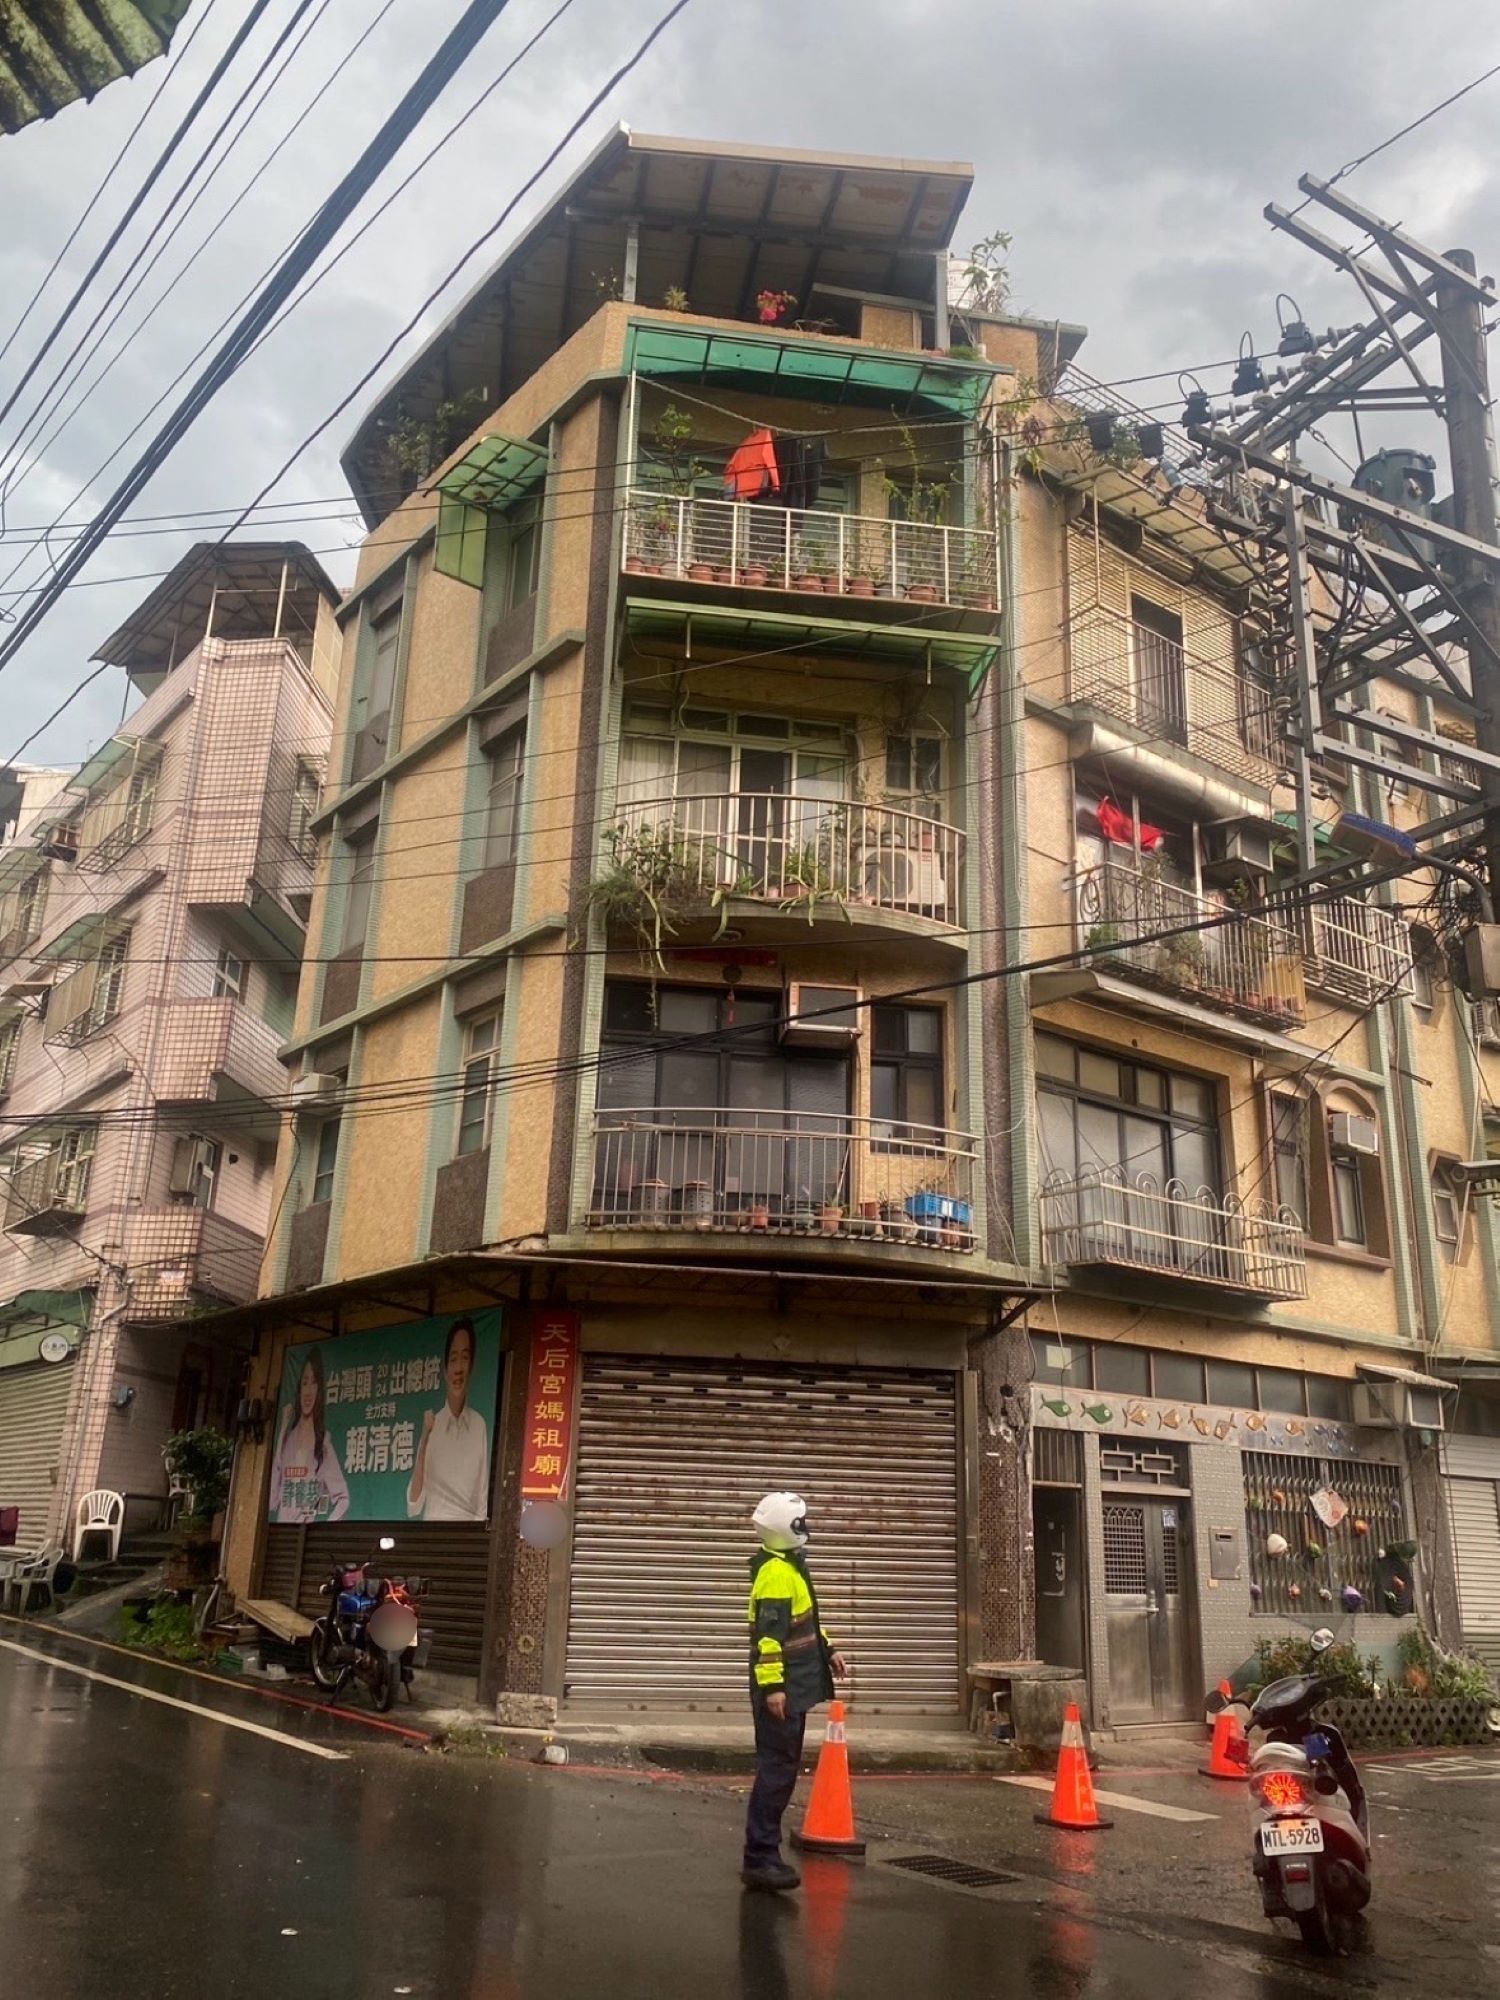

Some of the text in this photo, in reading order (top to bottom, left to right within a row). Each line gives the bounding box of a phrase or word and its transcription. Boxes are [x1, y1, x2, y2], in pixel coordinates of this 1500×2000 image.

[326, 1365, 373, 1404] 台灣頭
[391, 1355, 440, 1394] 出總統
[529, 1323, 570, 1476] 天后宮媽祖廟
[345, 1421, 414, 1473] 賴清德
[1263, 1828, 1320, 1848] MTL-5928
